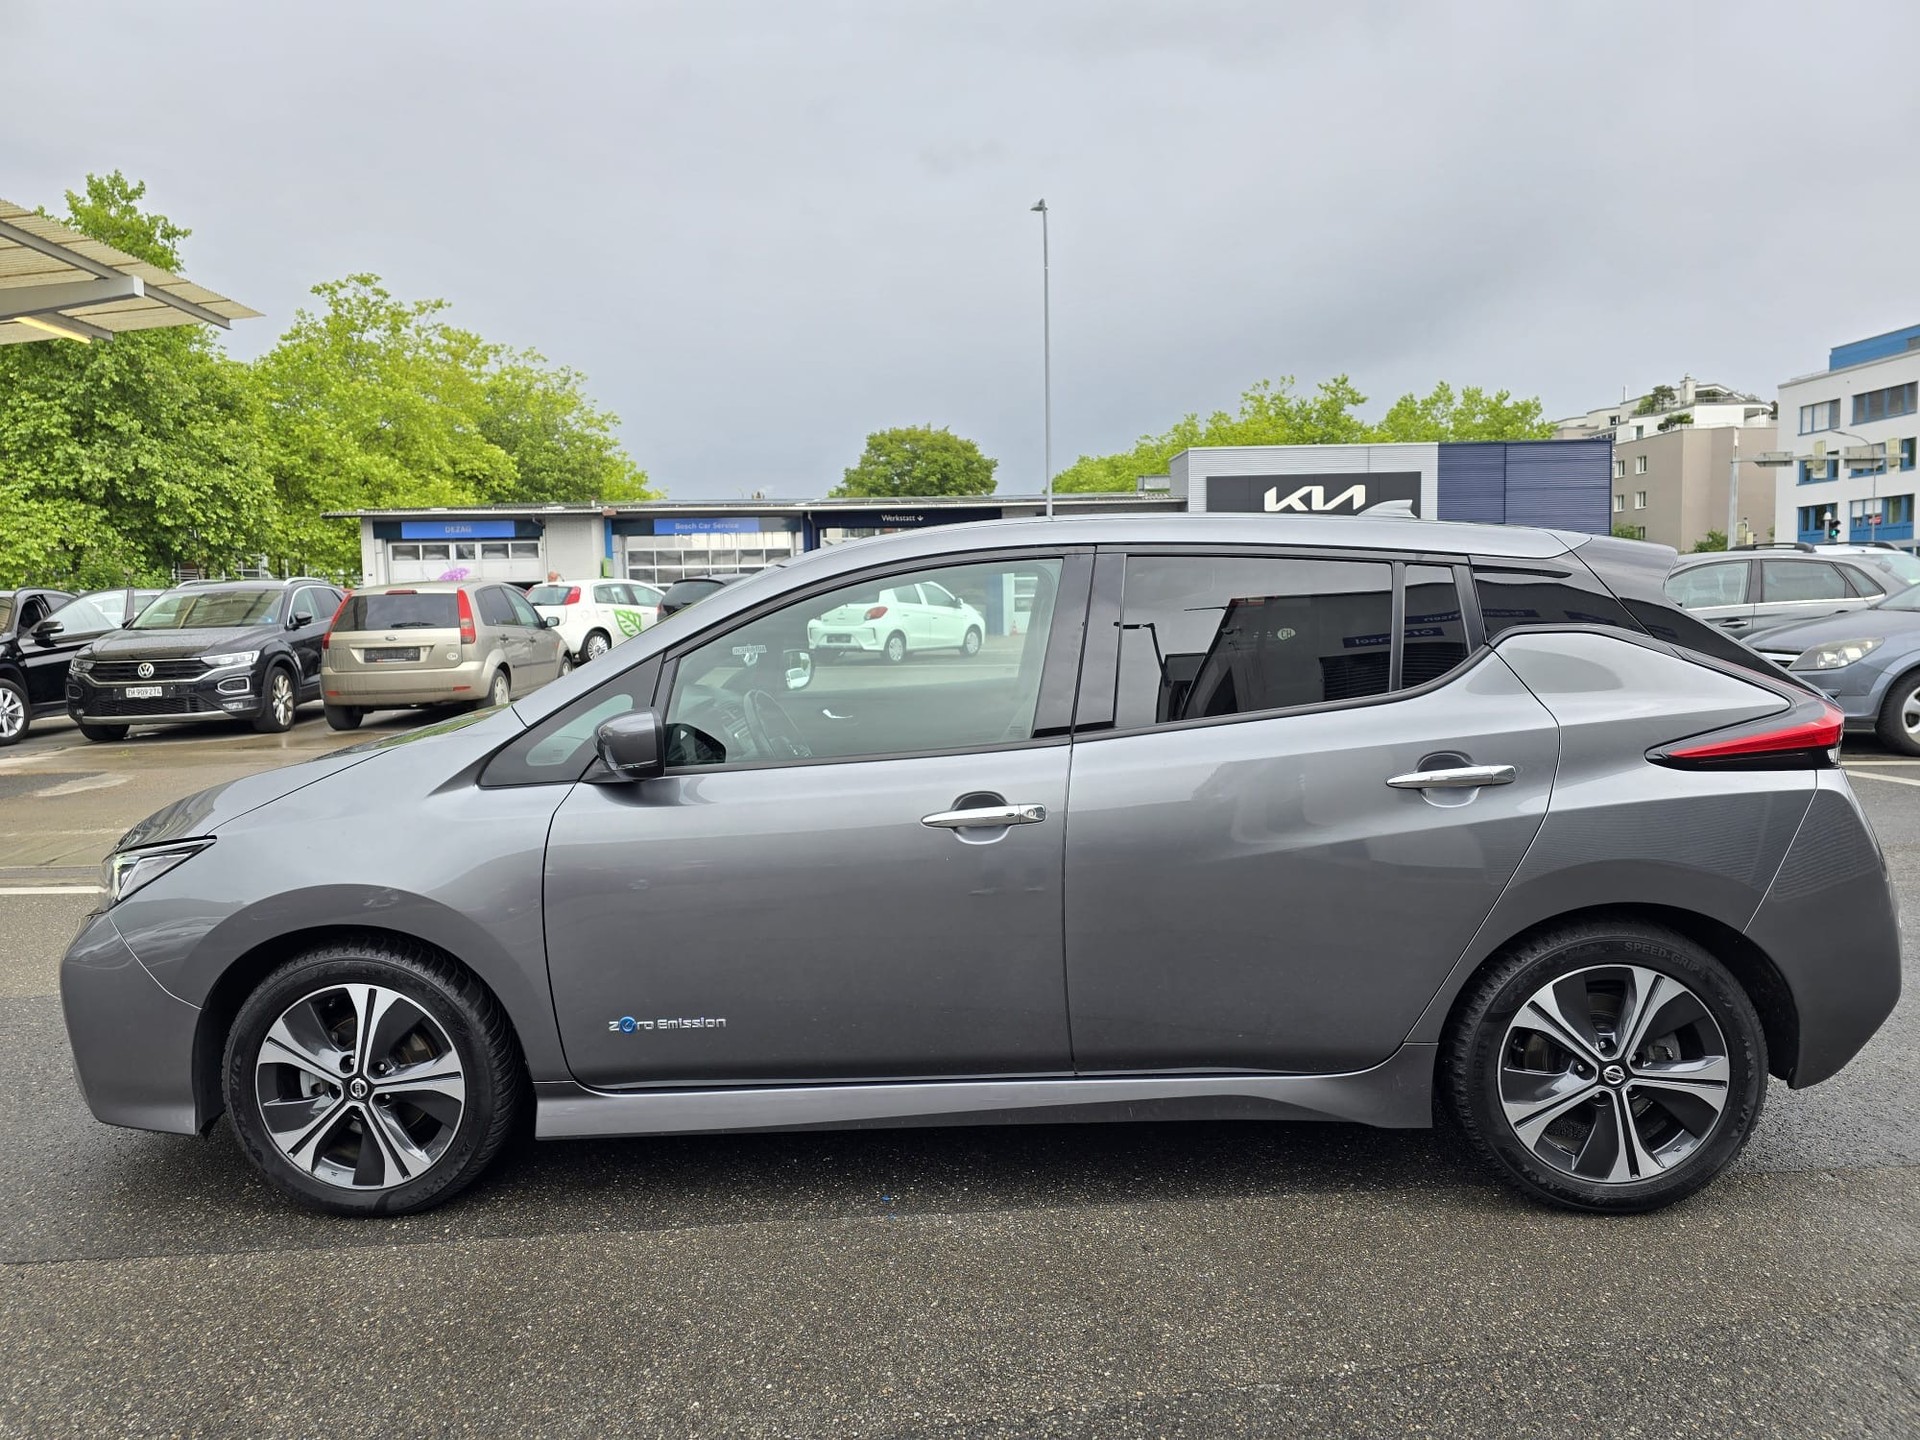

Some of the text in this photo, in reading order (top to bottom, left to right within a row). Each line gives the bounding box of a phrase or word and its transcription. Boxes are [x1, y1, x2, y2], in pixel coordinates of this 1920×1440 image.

[1264, 484, 1366, 512] KIA
[881, 514, 916, 522] Werkstatt
[674, 522, 697, 530] Bosch
[656, 1016, 727, 1030] Emission
